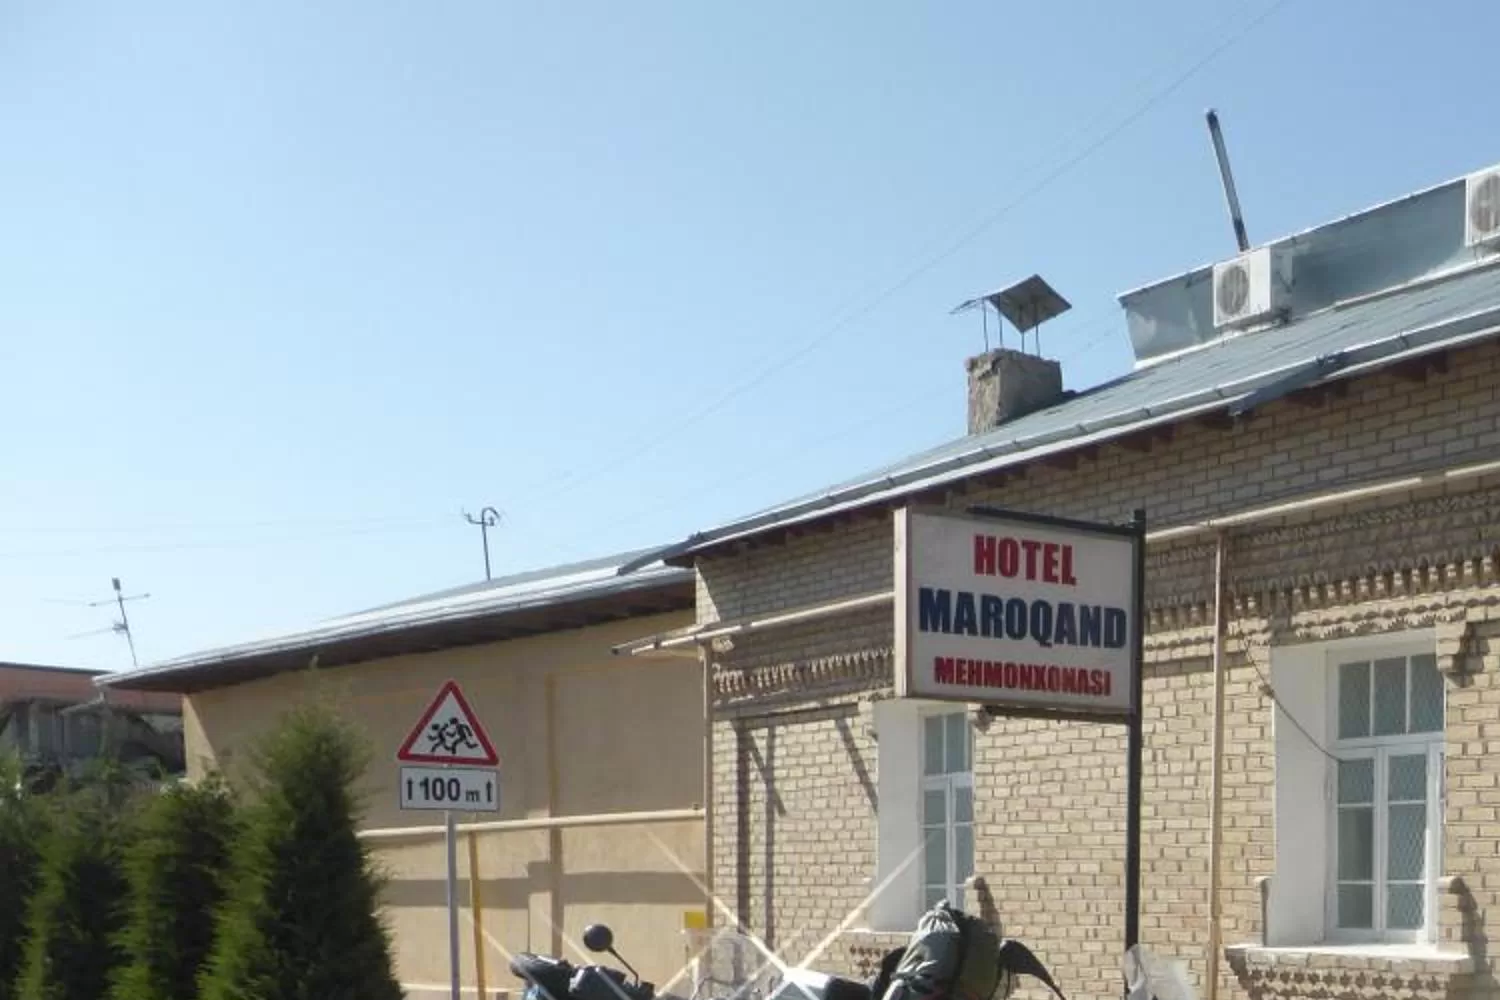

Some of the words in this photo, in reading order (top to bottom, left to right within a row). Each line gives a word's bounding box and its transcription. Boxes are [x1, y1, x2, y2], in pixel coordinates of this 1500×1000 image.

[974, 533, 1077, 586] HOTEL
[918, 586, 1127, 648] MAROQAND
[934, 656, 1112, 696] MEHMONXONASI
[419, 776, 461, 801] 100
[465, 789, 480, 802] m
